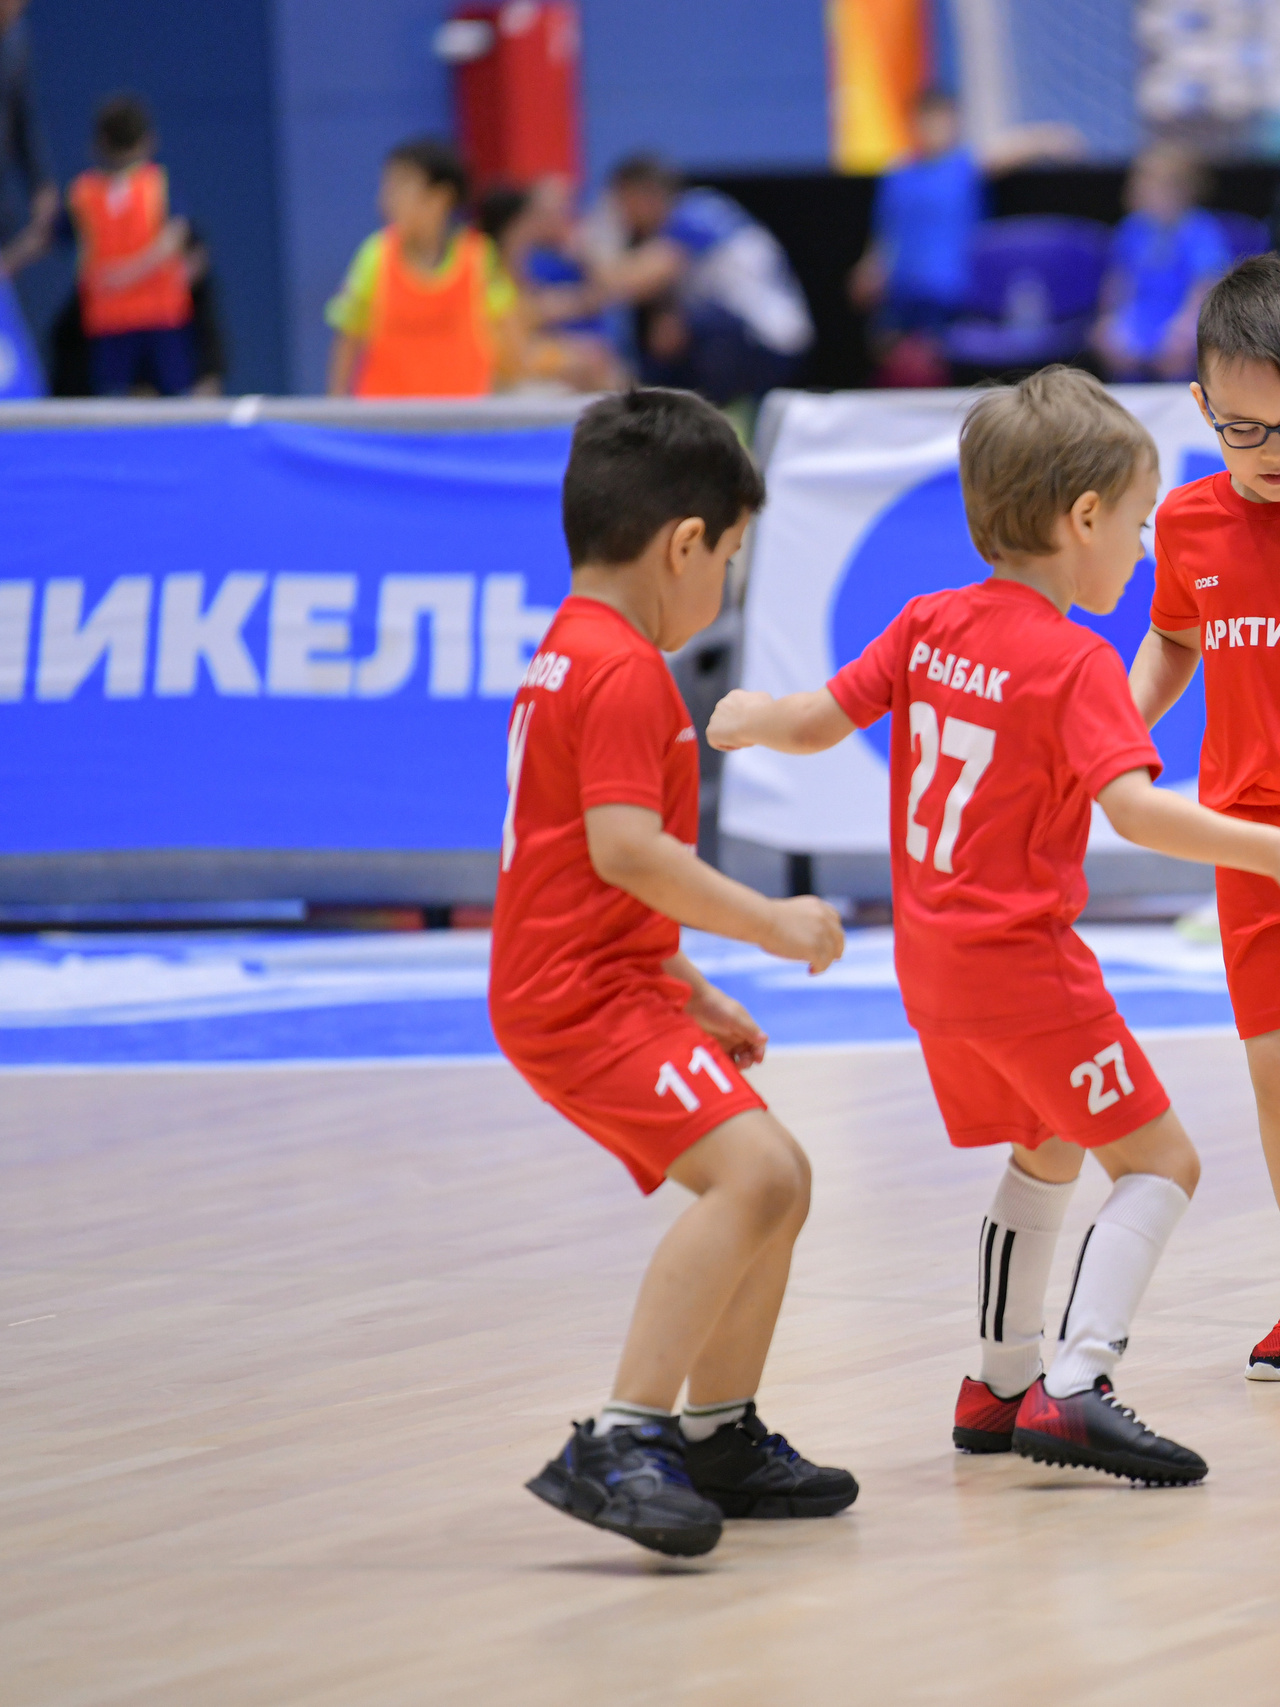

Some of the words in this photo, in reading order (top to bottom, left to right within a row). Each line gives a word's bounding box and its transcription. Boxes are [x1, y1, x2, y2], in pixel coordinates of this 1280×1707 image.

[0, 570, 559, 703] ИКЕЛЬ
[908, 641, 1010, 702] РЫБАК
[906, 701, 997, 874] 27
[654, 1045, 733, 1113] 11
[1069, 1040, 1135, 1116] 27
